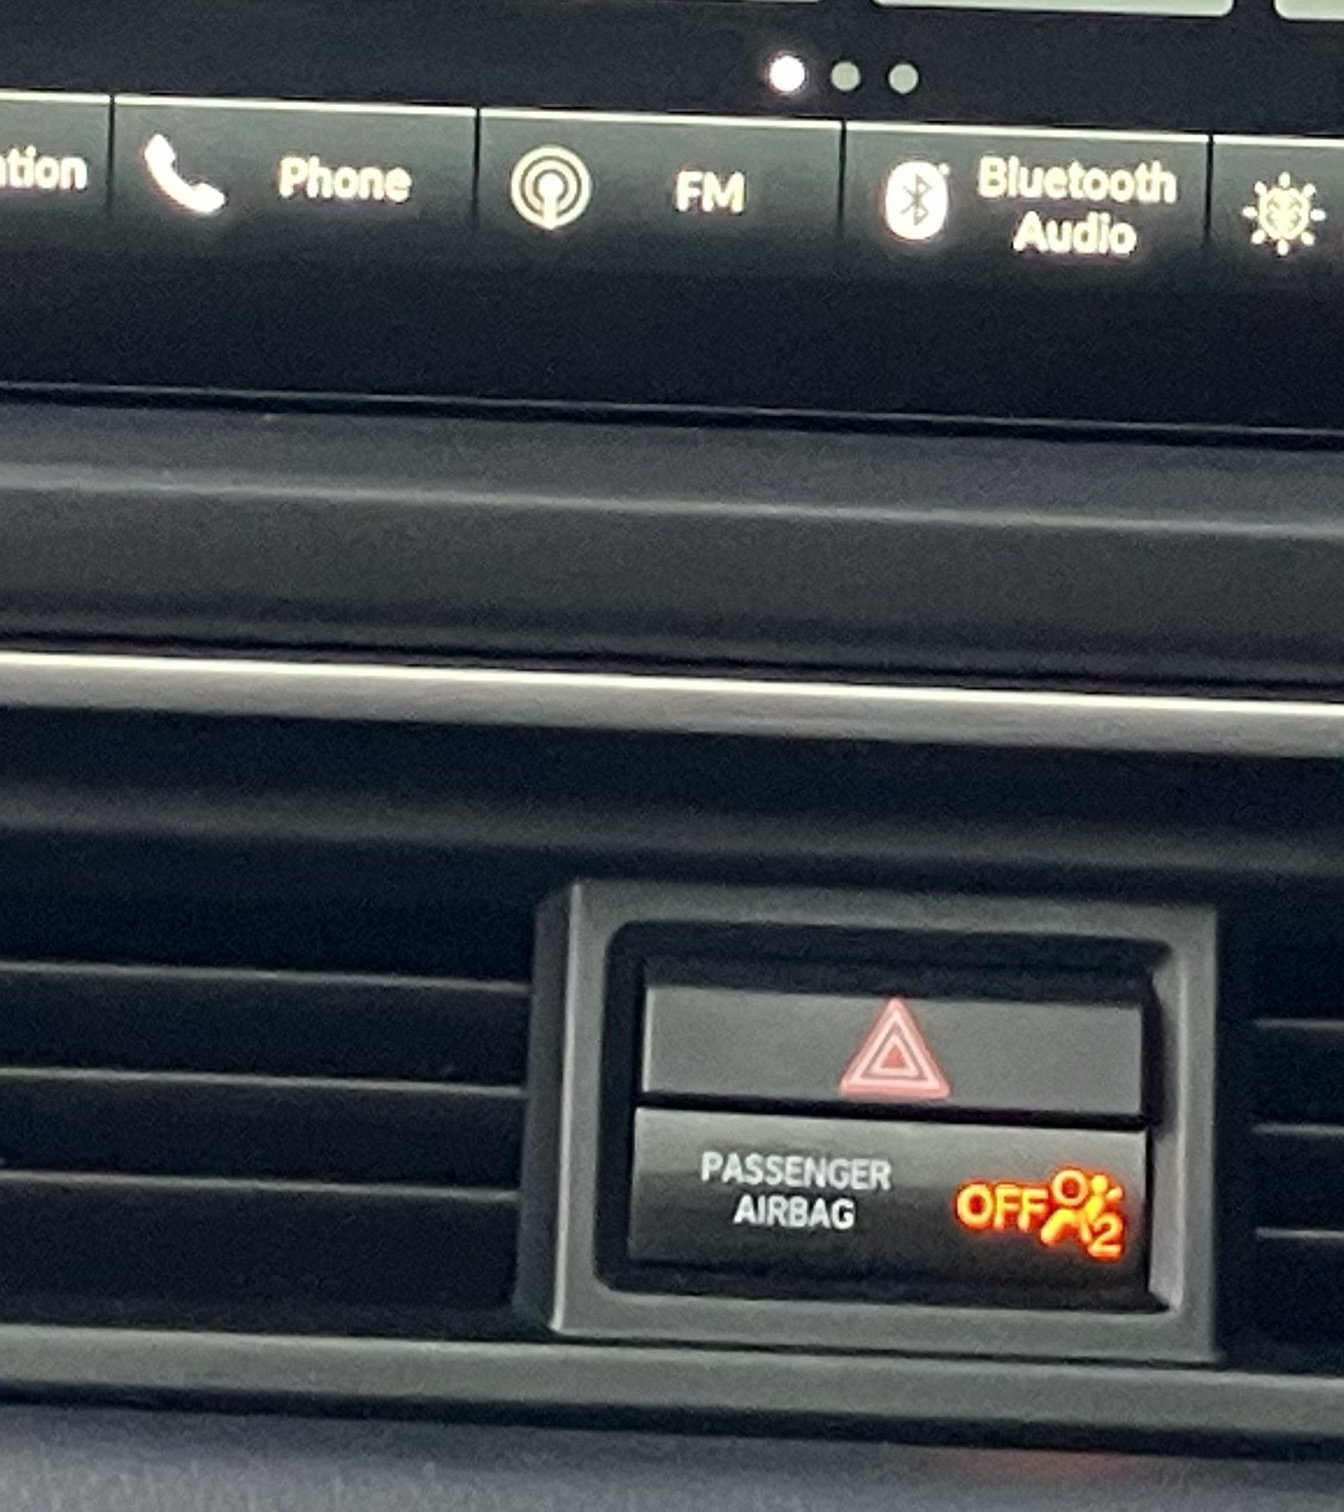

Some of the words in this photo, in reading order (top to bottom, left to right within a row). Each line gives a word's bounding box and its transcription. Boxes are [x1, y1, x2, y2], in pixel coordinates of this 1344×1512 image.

[279, 155, 413, 203] Phone
[675, 170, 745, 213] FM
[978, 155, 1177, 204] Bluetooth
[1013, 210, 1138, 256] Audio
[701, 1150, 892, 1190] PASSENGER
[733, 1194, 855, 1230] AIRBAG
[956, 1182, 1048, 1234] OFF
